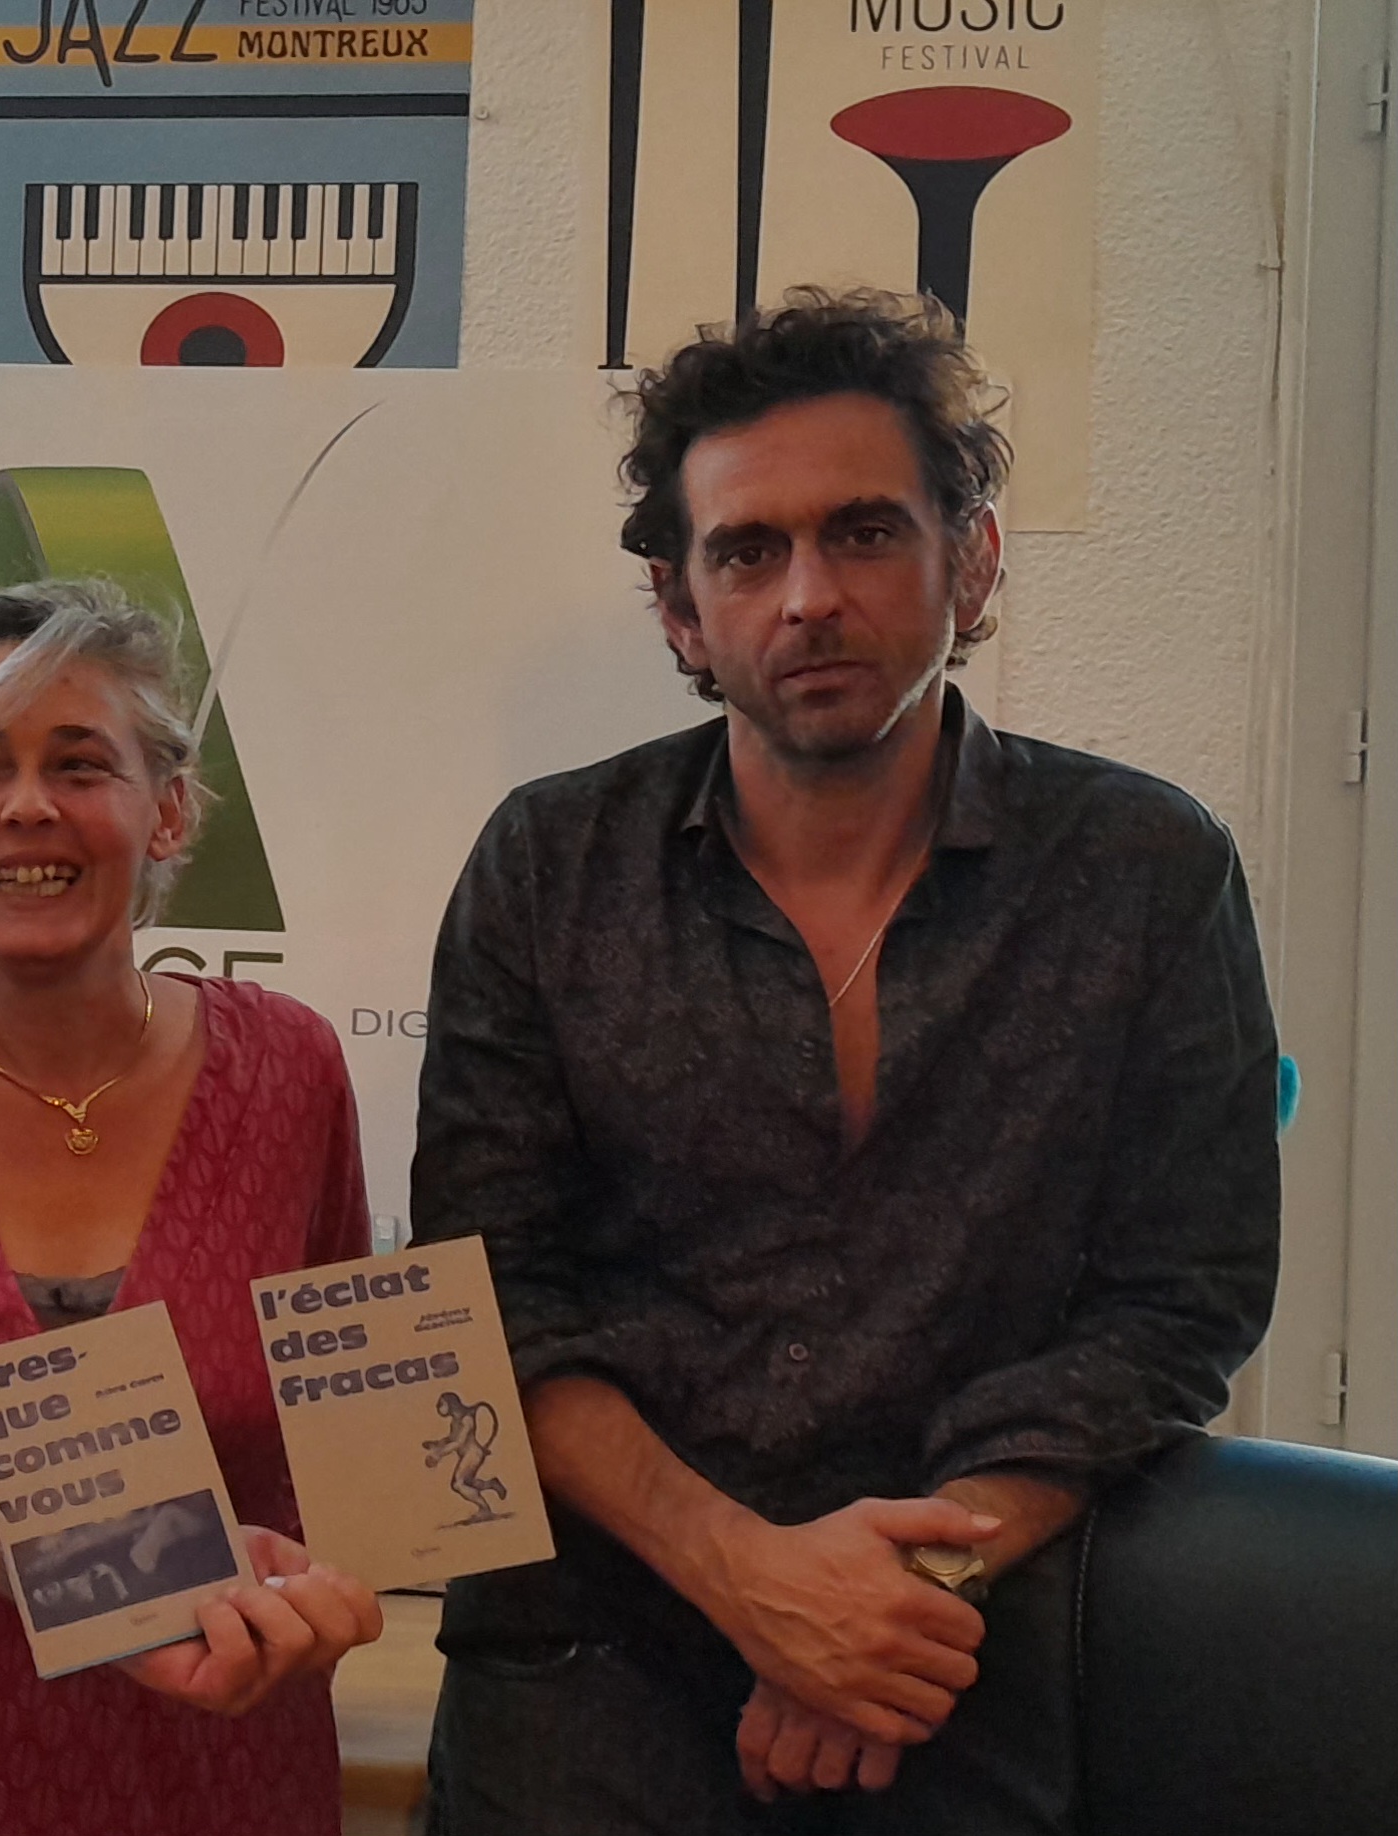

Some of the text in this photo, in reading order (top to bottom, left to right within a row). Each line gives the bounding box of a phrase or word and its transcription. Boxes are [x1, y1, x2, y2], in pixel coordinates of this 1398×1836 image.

[850, 0, 1065, 32] MUSIC
[2, 0, 219, 88] JAZZ
[237, 28, 430, 60] MONTREUX
[881, 45, 1031, 70] FESTIVAL
[351, 1008, 428, 1038] DIG
[259, 1263, 431, 1322] l'éclat
[269, 1323, 369, 1364] des
[278, 1351, 461, 1407] fracas
